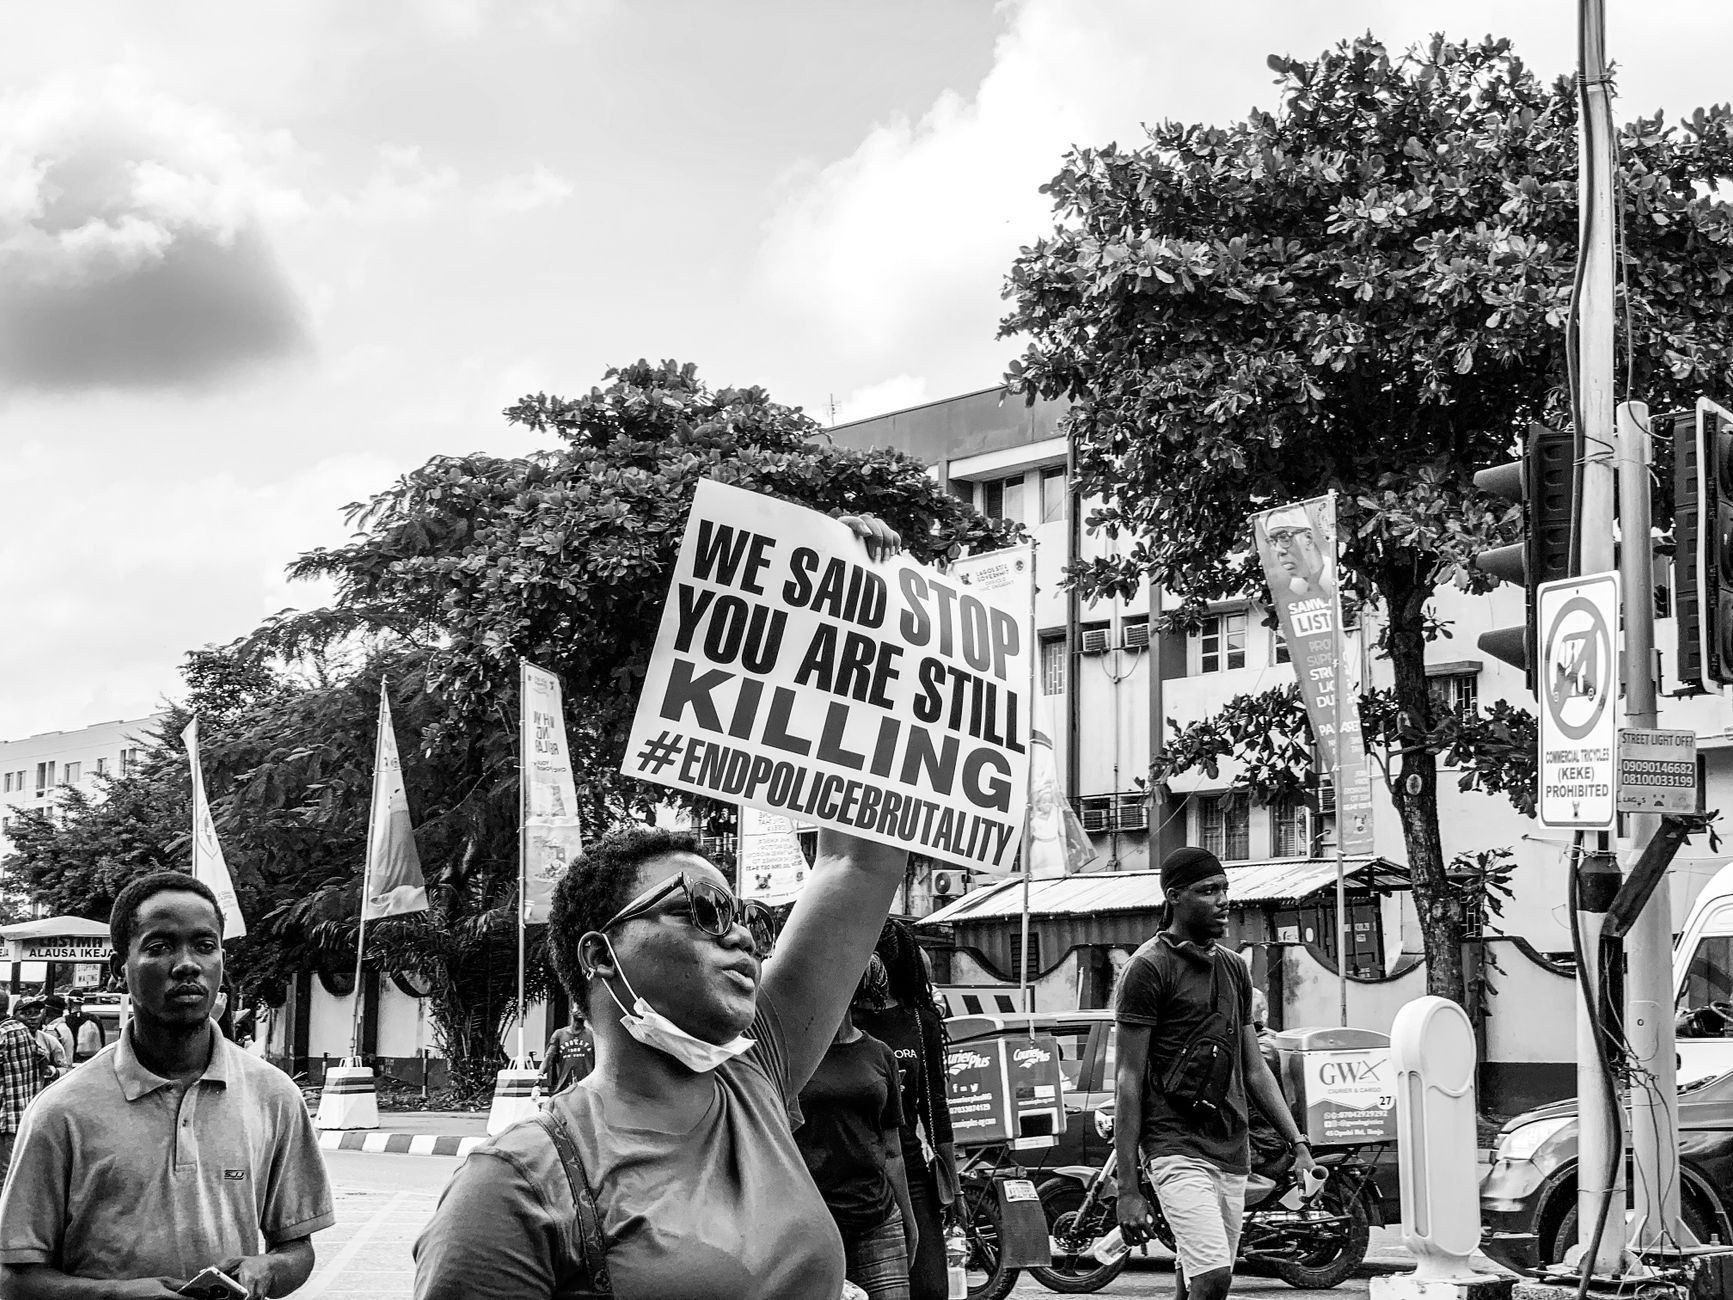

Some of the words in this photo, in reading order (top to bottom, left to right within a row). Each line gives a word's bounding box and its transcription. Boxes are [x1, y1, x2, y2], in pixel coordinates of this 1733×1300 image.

[693, 519, 777, 587] WE
[782, 546, 888, 630] SAID
[898, 566, 1020, 682] STOP
[673, 582, 789, 675] YOU
[793, 621, 905, 711] ARE
[912, 655, 1026, 755] STILL
[659, 657, 1012, 814] KILLING
[1622, 732, 1650, 745] STREET
[1651, 735, 1673, 746] LIGHT
[1546, 750, 1579, 764] COMMERCIAL
[1580, 748, 1609, 762] TRICYCLES
[1557, 766, 1595, 782] (KEKE)
[1623, 761, 1694, 775] 09090146682
[1623, 773, 1694, 787] 08100033199
[637, 730, 1014, 867] #ENDPOLICEBRUTALITY
[1545, 784, 1609, 798] PROHIBITED
[29, 949, 76, 957] ALAUSA
[81, 949, 113, 957] IKEJA
[1319, 1059, 1387, 1086] GWX
[1379, 1096, 1392, 1106] 27
